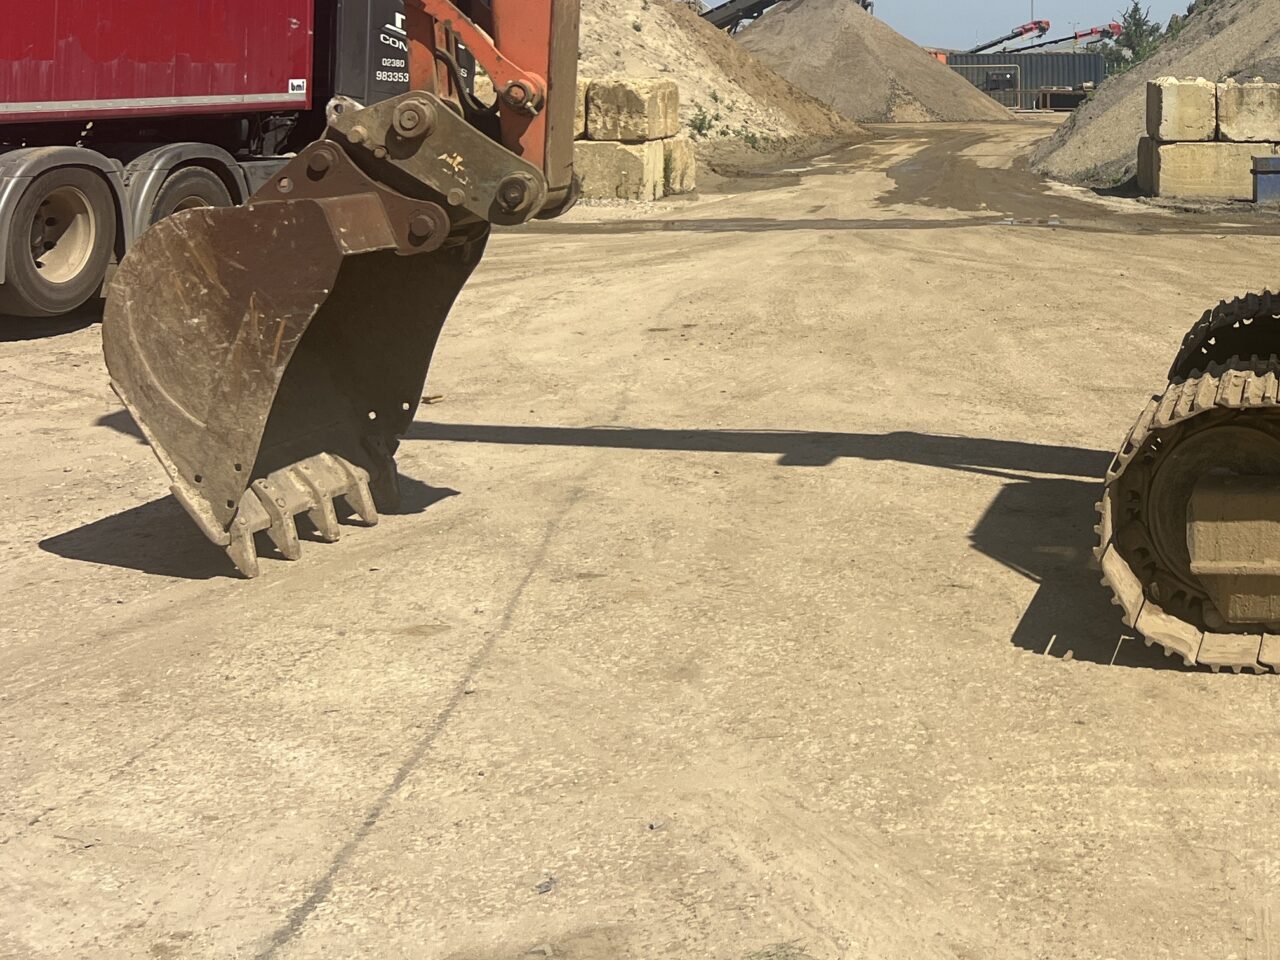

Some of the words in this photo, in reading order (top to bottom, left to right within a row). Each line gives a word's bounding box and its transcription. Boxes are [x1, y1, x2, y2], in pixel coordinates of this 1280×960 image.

[381, 58, 405, 68] 02380
[375, 71, 409, 82] 983353
[290, 80, 305, 92] bmi
